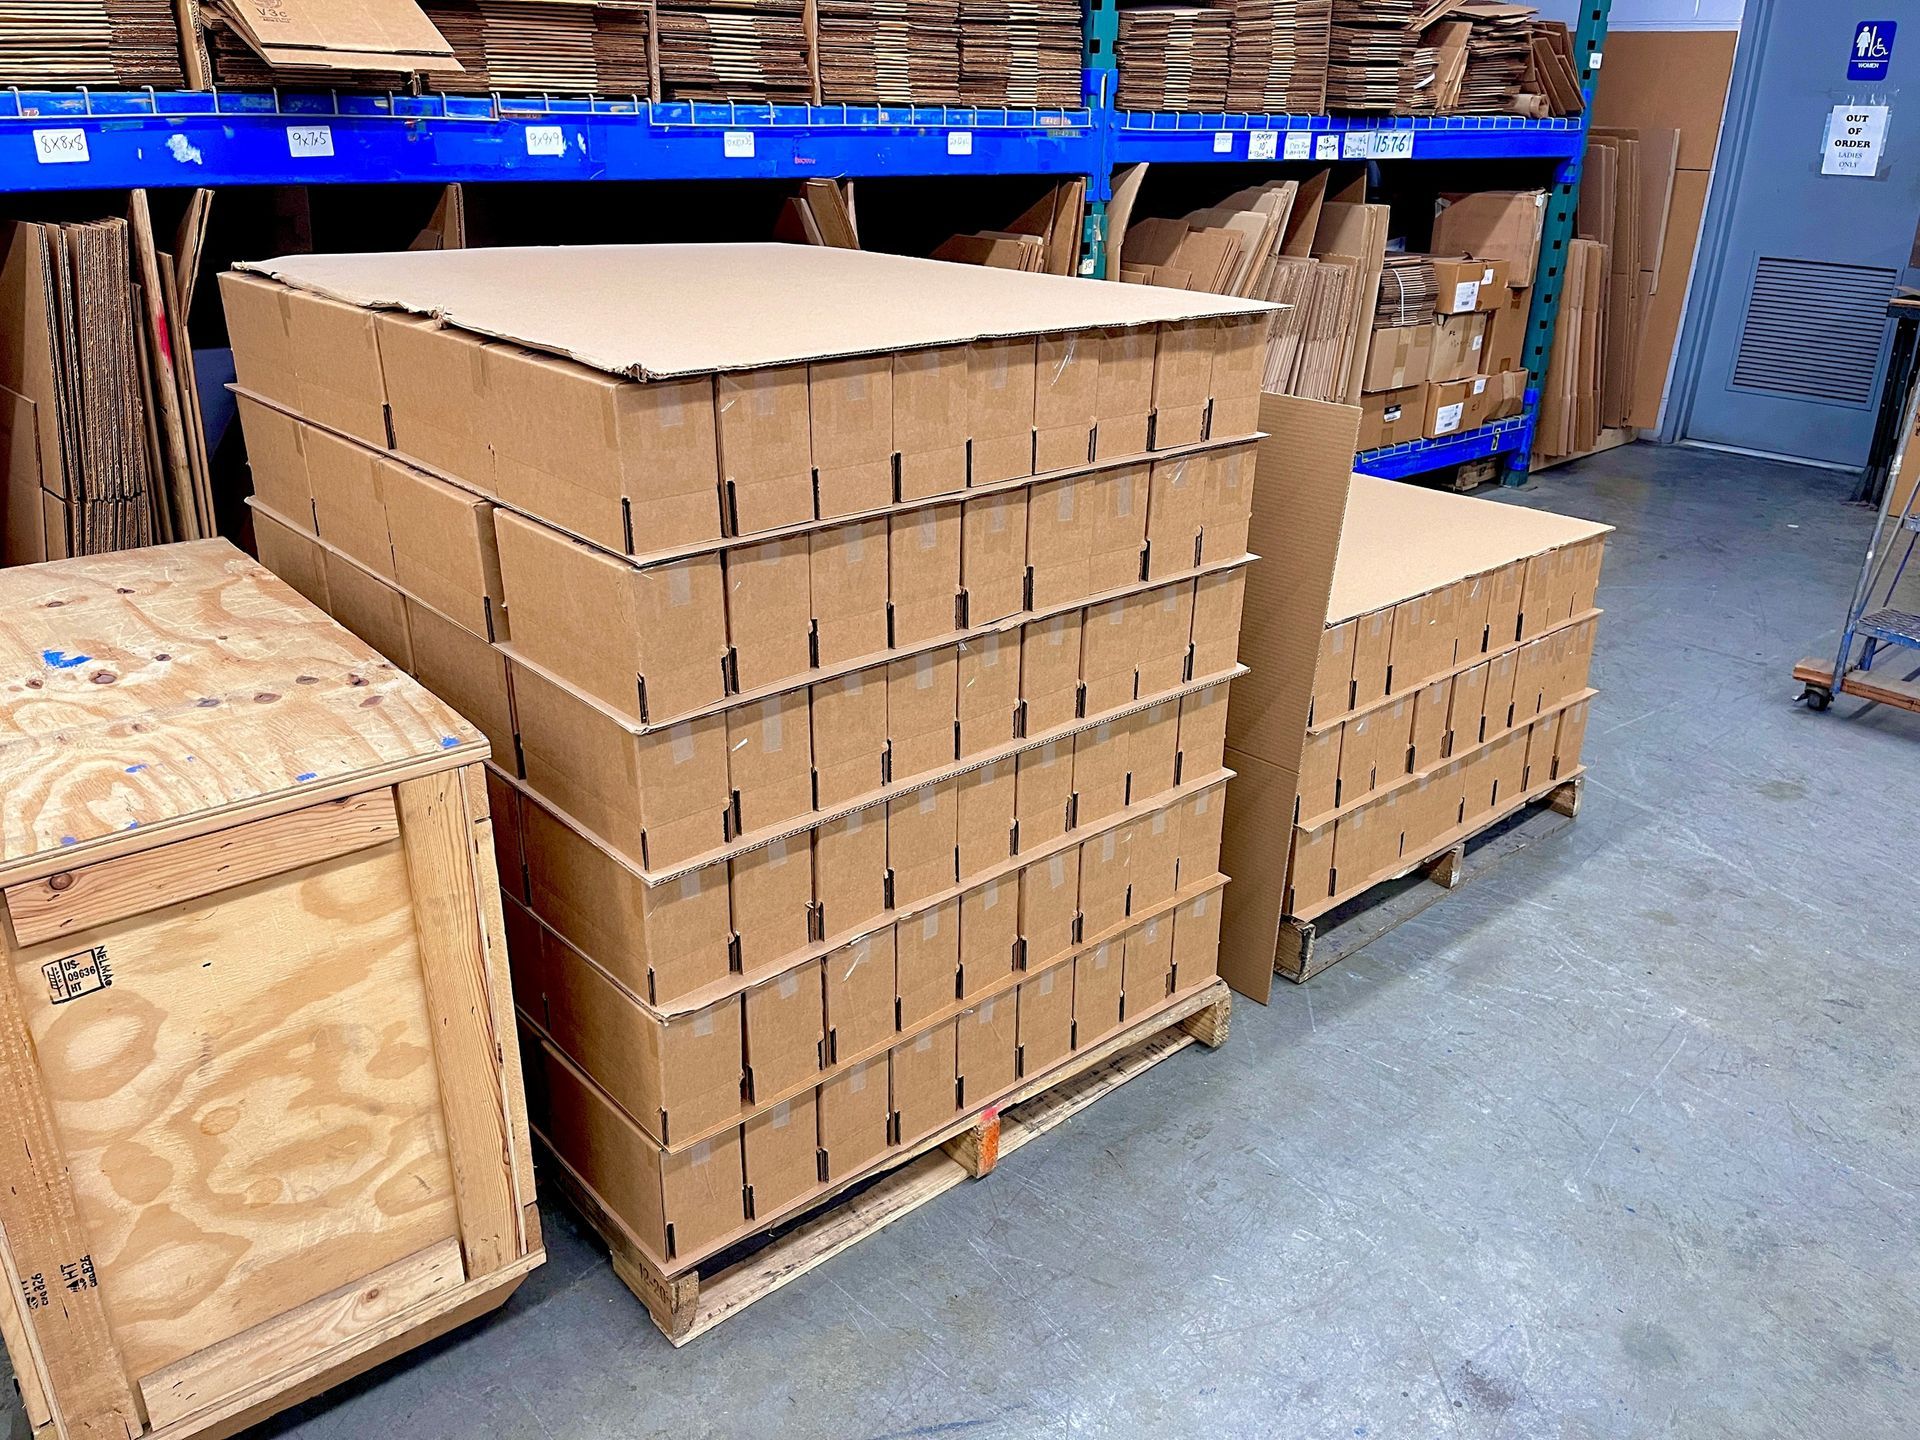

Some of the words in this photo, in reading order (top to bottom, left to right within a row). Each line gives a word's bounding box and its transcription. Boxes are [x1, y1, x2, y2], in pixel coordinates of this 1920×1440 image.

[1846, 114, 1869, 122] OUT
[1848, 127, 1862, 135] OF
[292, 131, 328, 146] 9x7x5
[1834, 139, 1871, 148] ORDER
[94, 945, 115, 981] NELMA
[67, 965, 96, 982] 09636
[70, 981, 82, 993] HT
[60, 1262, 80, 1281] HT
